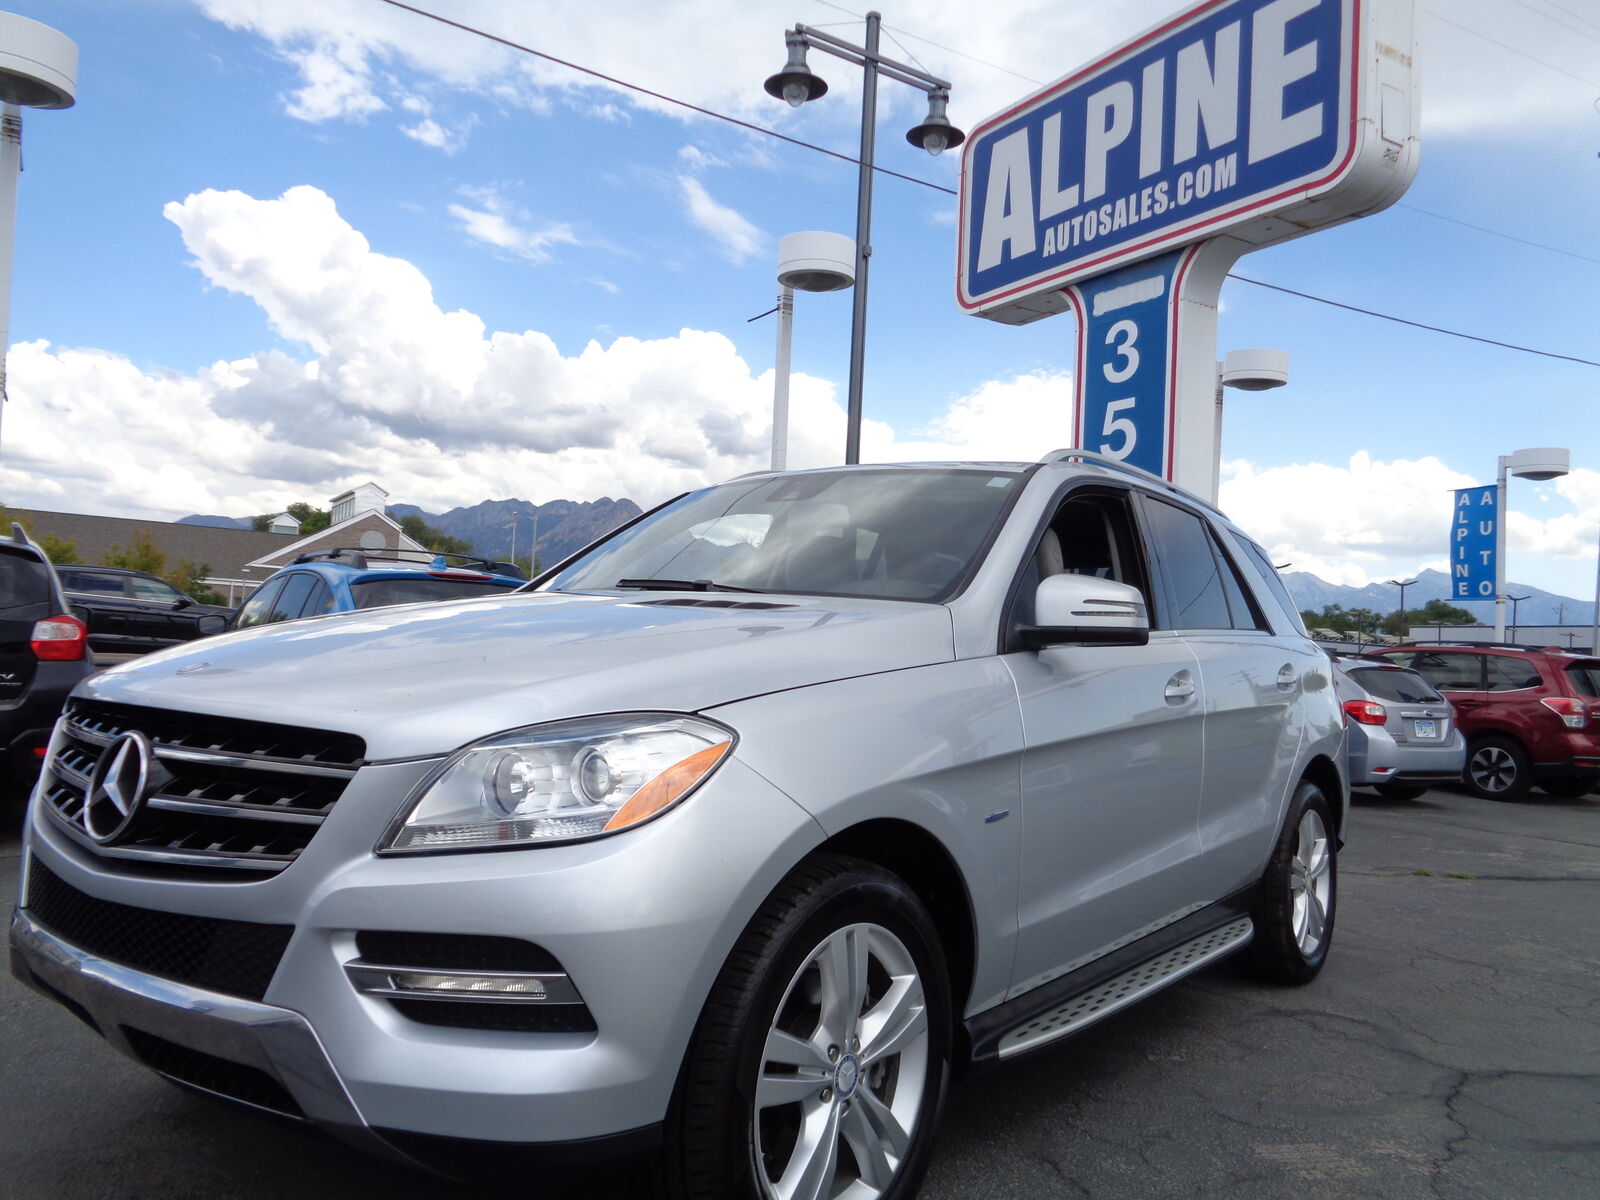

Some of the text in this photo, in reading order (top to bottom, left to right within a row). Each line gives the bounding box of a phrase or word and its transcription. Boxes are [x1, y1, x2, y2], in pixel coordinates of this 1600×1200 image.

[977, 0, 1322, 273] ALPINE
[1042, 152, 1237, 258] AUTOSALES.COM
[1456, 493, 1471, 596] ALPINE
[1478, 491, 1494, 596] AUTO
